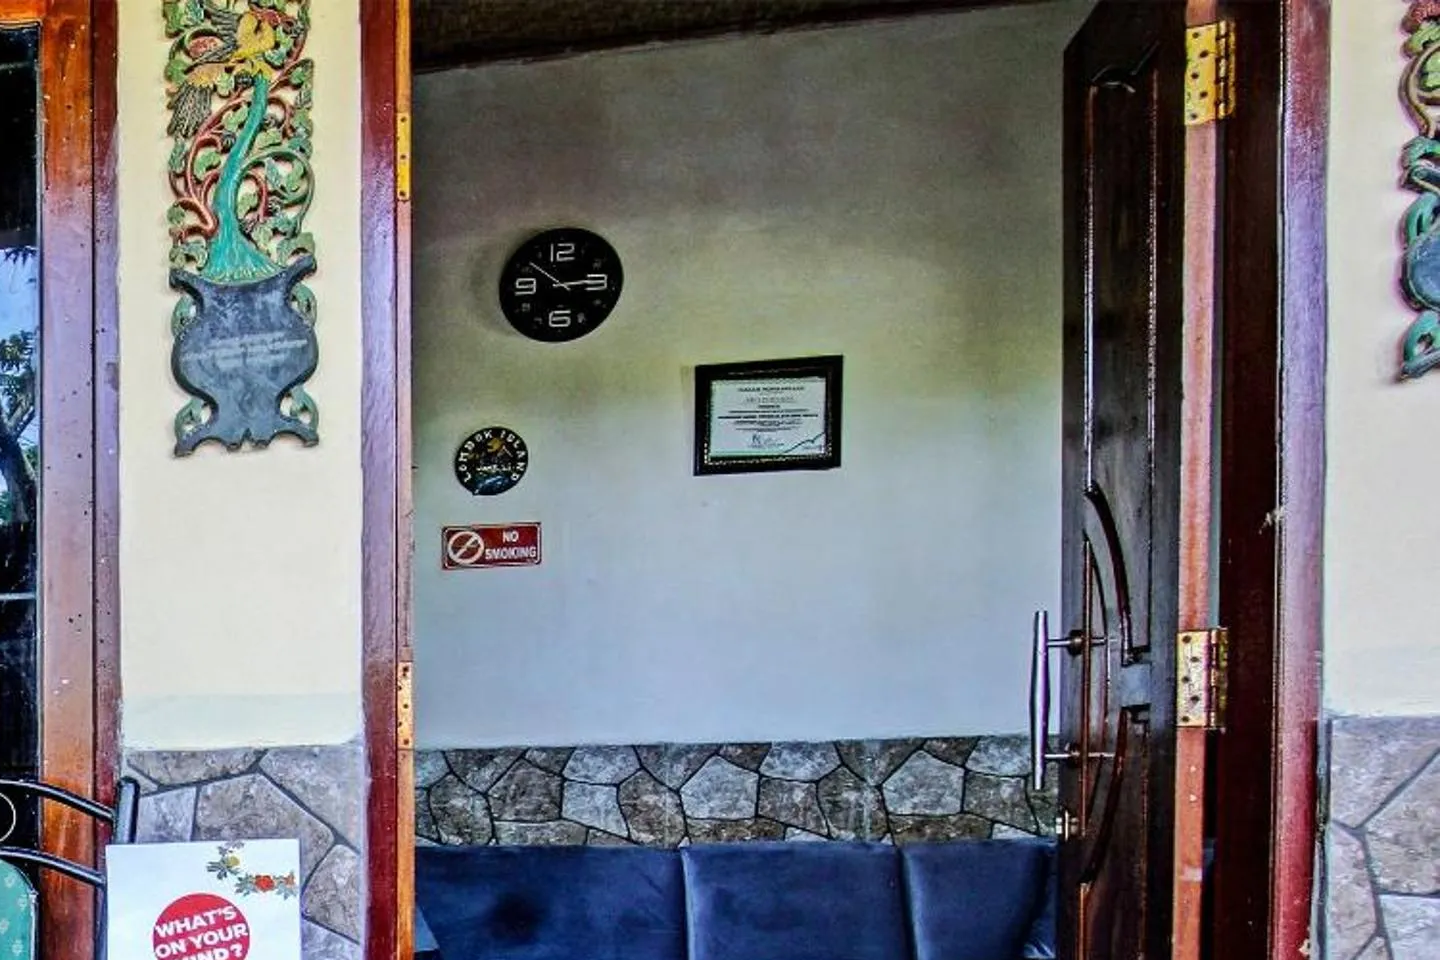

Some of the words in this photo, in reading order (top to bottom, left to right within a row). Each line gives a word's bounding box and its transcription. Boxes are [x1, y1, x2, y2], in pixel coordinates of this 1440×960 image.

[550, 243, 575, 262] 12
[514, 278, 536, 296] 9
[585, 274, 608, 290] 3
[548, 310, 571, 327] 6
[502, 531, 519, 543] NO
[485, 547, 537, 560] SMOKING
[155, 906, 237, 938] WHAT'S
[155, 939, 187, 959] ON
[188, 923, 249, 949] YOUR
